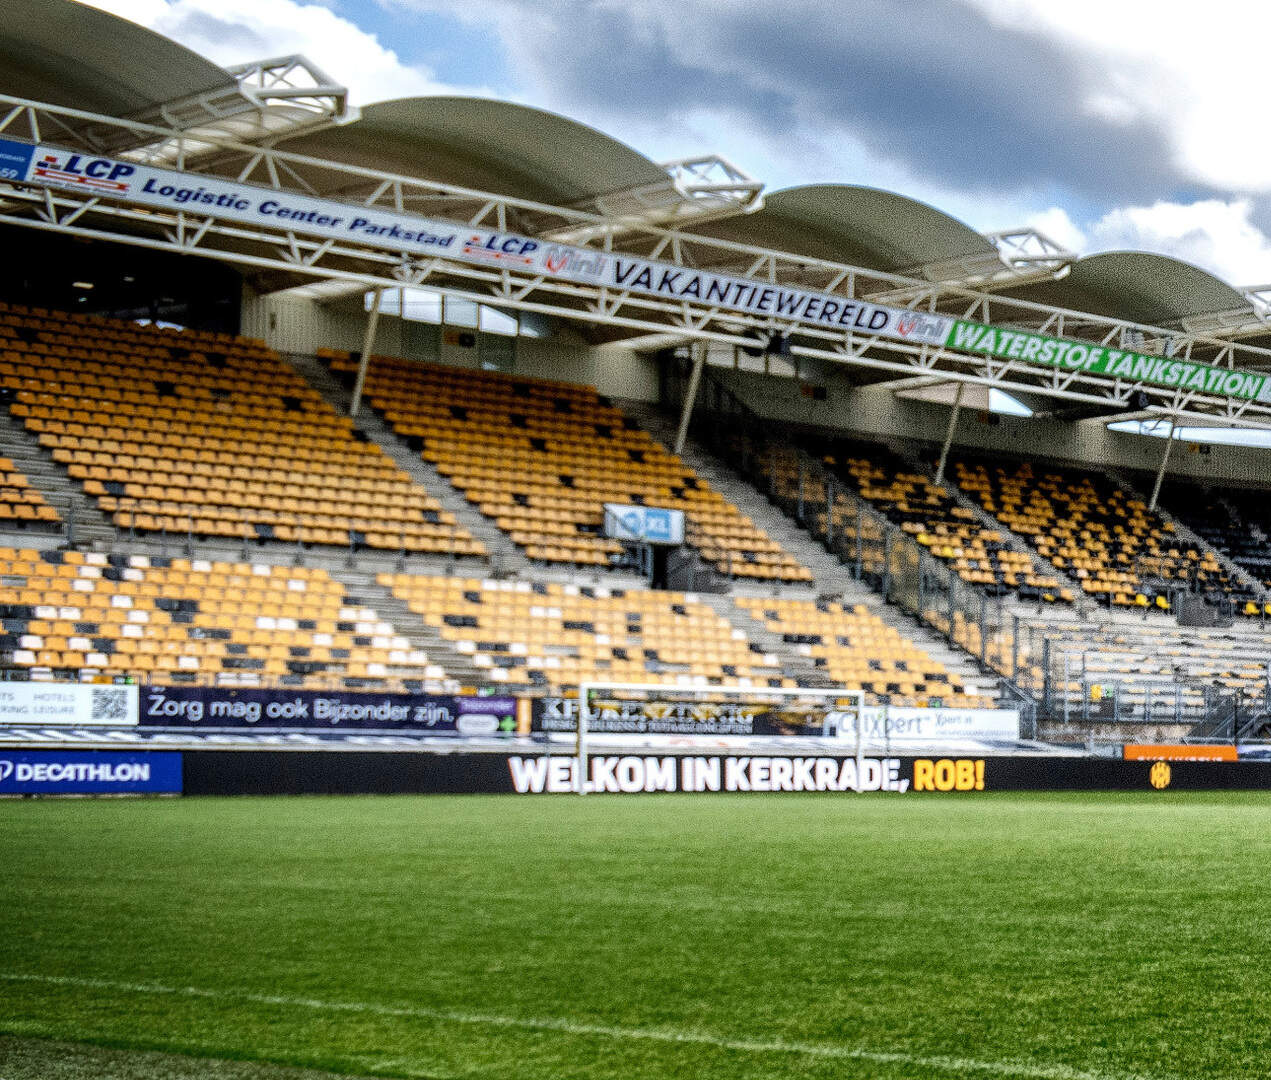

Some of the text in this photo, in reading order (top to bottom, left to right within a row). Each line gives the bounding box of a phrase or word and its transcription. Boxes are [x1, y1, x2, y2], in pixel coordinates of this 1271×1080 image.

[63, 155, 135, 180] LCP
[142, 178, 250, 211] Logistic
[258, 199, 343, 229] Center
[350, 218, 456, 249] Parkstad
[486, 235, 538, 255] LCP
[614, 260, 890, 331] VAKANTIEWERELD
[953, 321, 1263, 398] WATERSTOF TANKSTATION
[147, 694, 204, 721] Zorg
[210, 701, 261, 722] mag
[266, 697, 309, 718] ook
[314, 698, 410, 724] Bijzonder
[414, 699, 454, 725] zijn.
[15, 763, 150, 782] DECATHLON
[508, 756, 986, 793] WELKOM IN KERKRADE, ROB!
